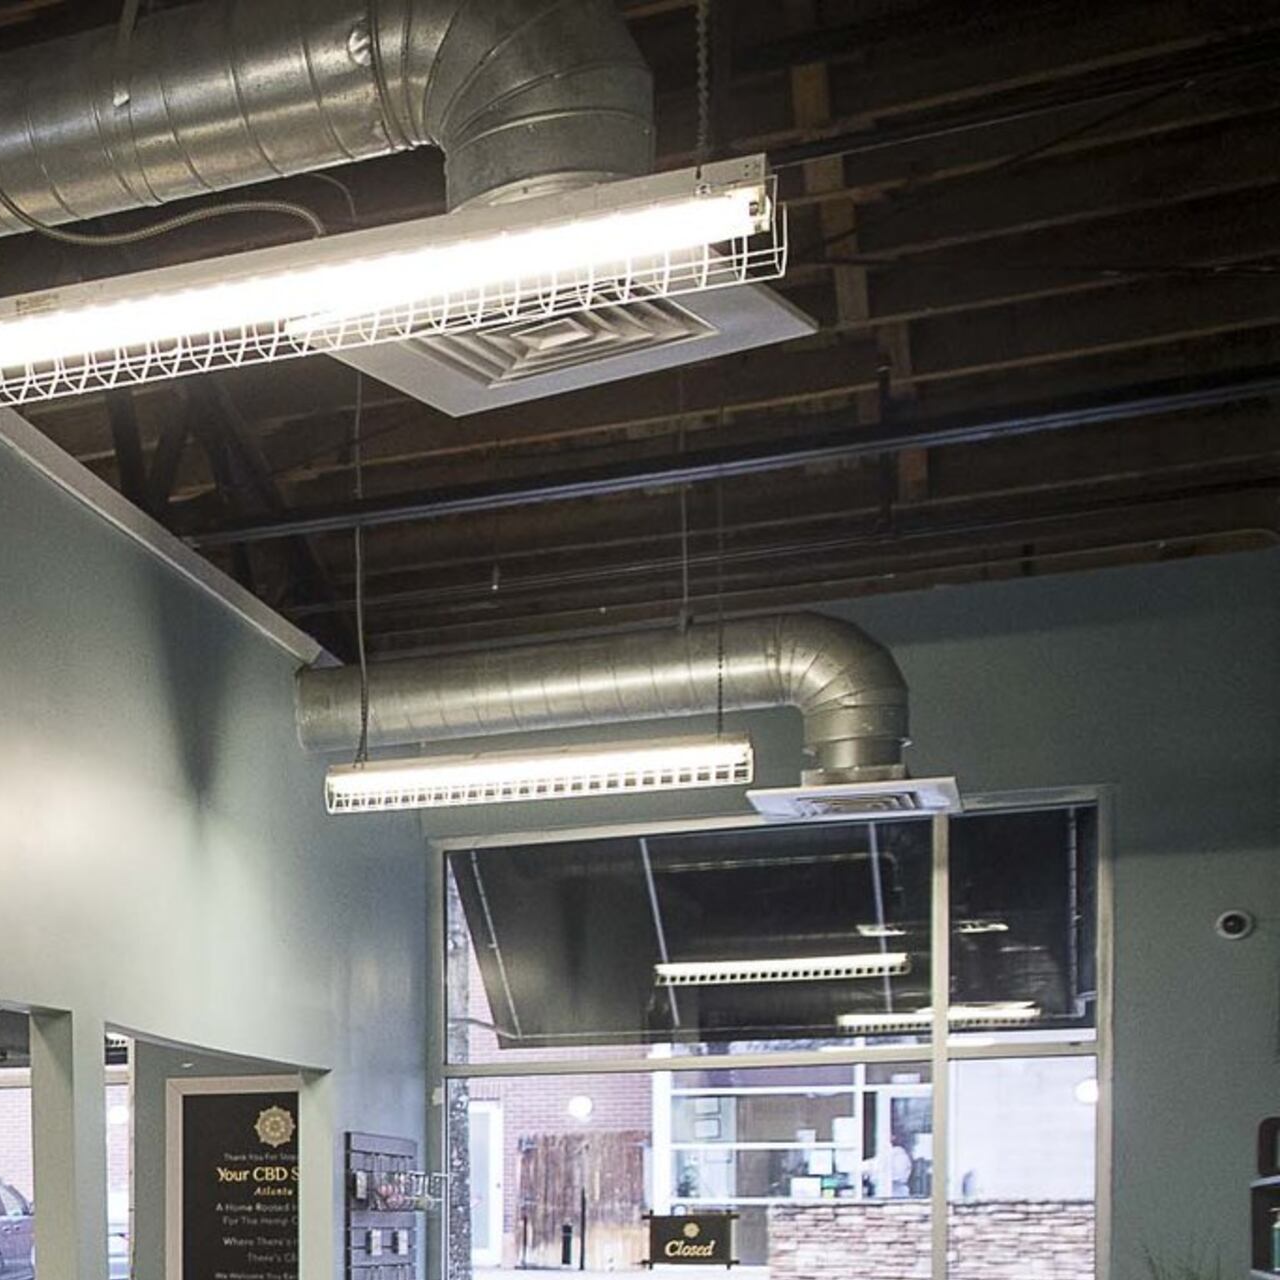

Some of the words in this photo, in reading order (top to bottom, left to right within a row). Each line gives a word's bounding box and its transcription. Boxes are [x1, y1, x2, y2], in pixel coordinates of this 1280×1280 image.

[216, 1166, 250, 1182] Your
[252, 1166, 289, 1182] CBD
[664, 1239, 716, 1257] Closed
